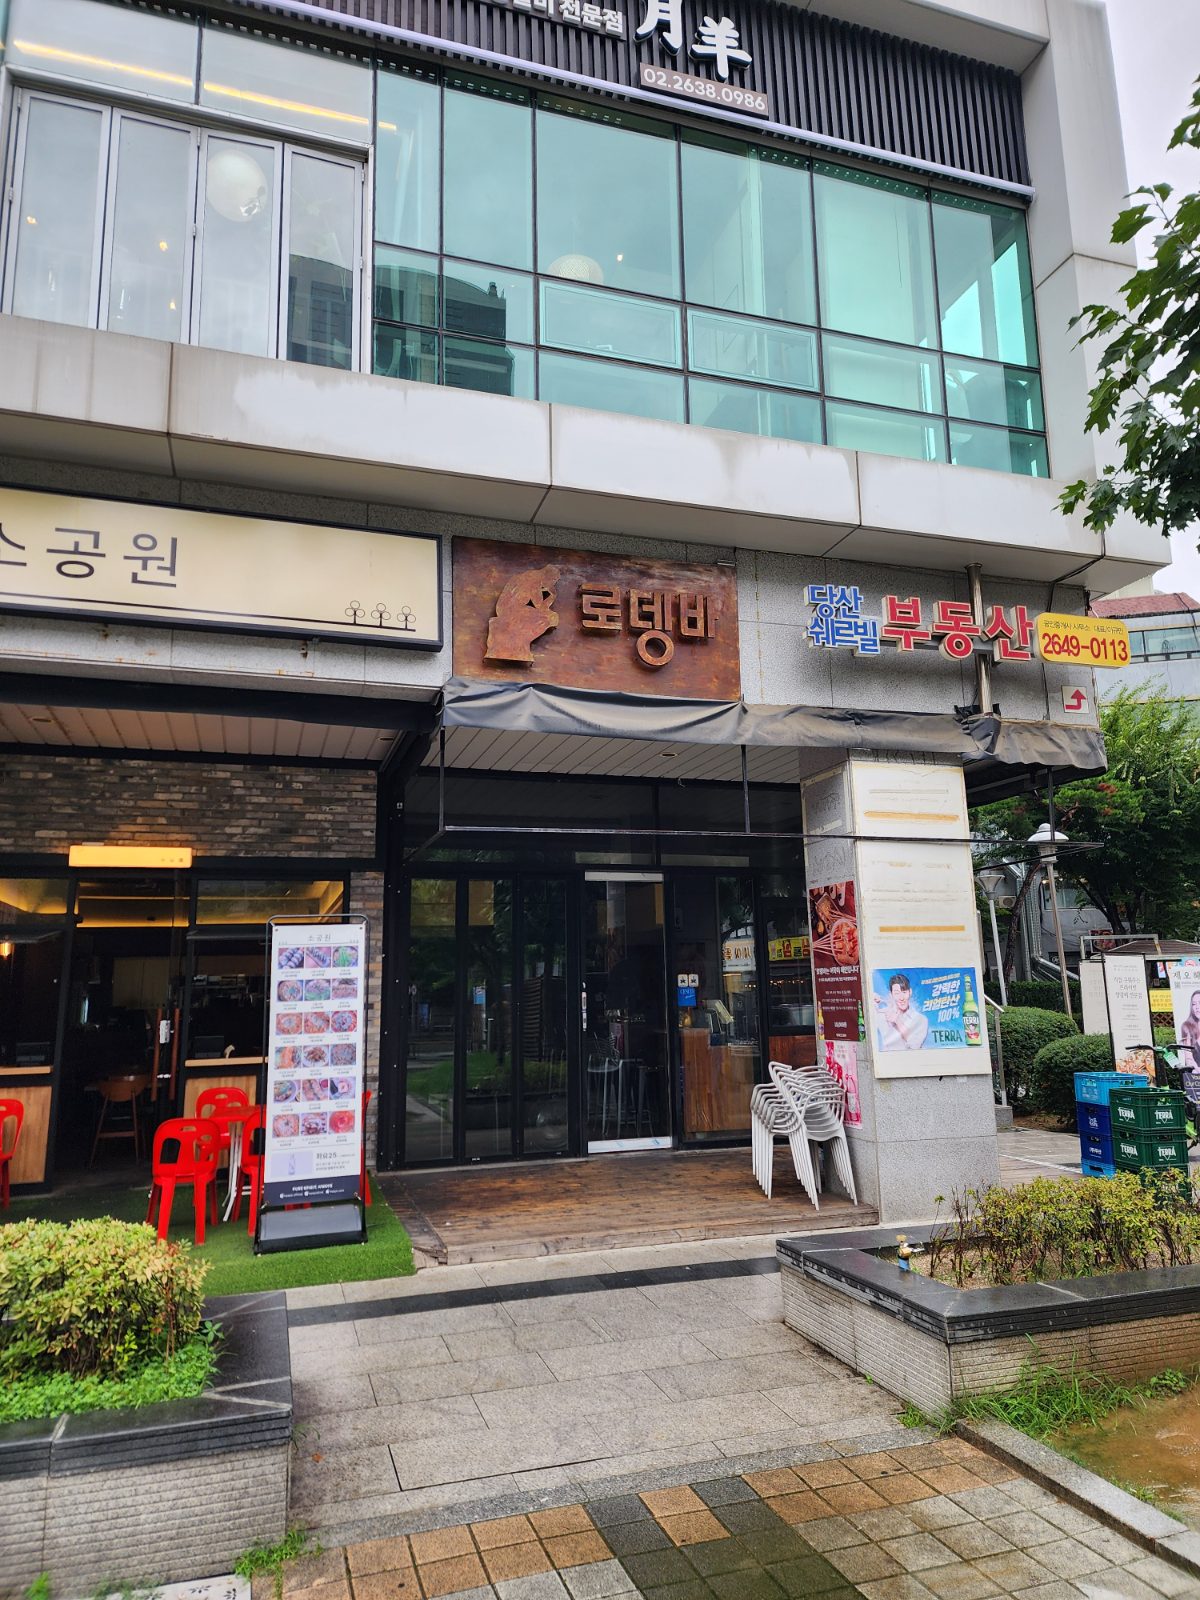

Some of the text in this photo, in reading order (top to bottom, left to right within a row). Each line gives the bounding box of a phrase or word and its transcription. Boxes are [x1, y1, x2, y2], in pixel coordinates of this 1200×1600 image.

[559, 0, 623, 34] 전문점
[643, 68, 767, 111] 02.2638.0986
[806, 584, 864, 619] 당산
[577, 583, 719, 667] 로뎅바
[806, 616, 880, 654] 쉐르빌
[881, 595, 1035, 661] 부동산
[1042, 632, 1128, 661] 2649-0113
[937, 1007, 960, 1023] 100%
[931, 1030, 963, 1043] TERRA
[1118, 1107, 1135, 1120] TERRA
[1154, 1109, 1174, 1120] TERRA
[1120, 1143, 1138, 1156] TERRA
[1157, 1146, 1177, 1157] TERRA
